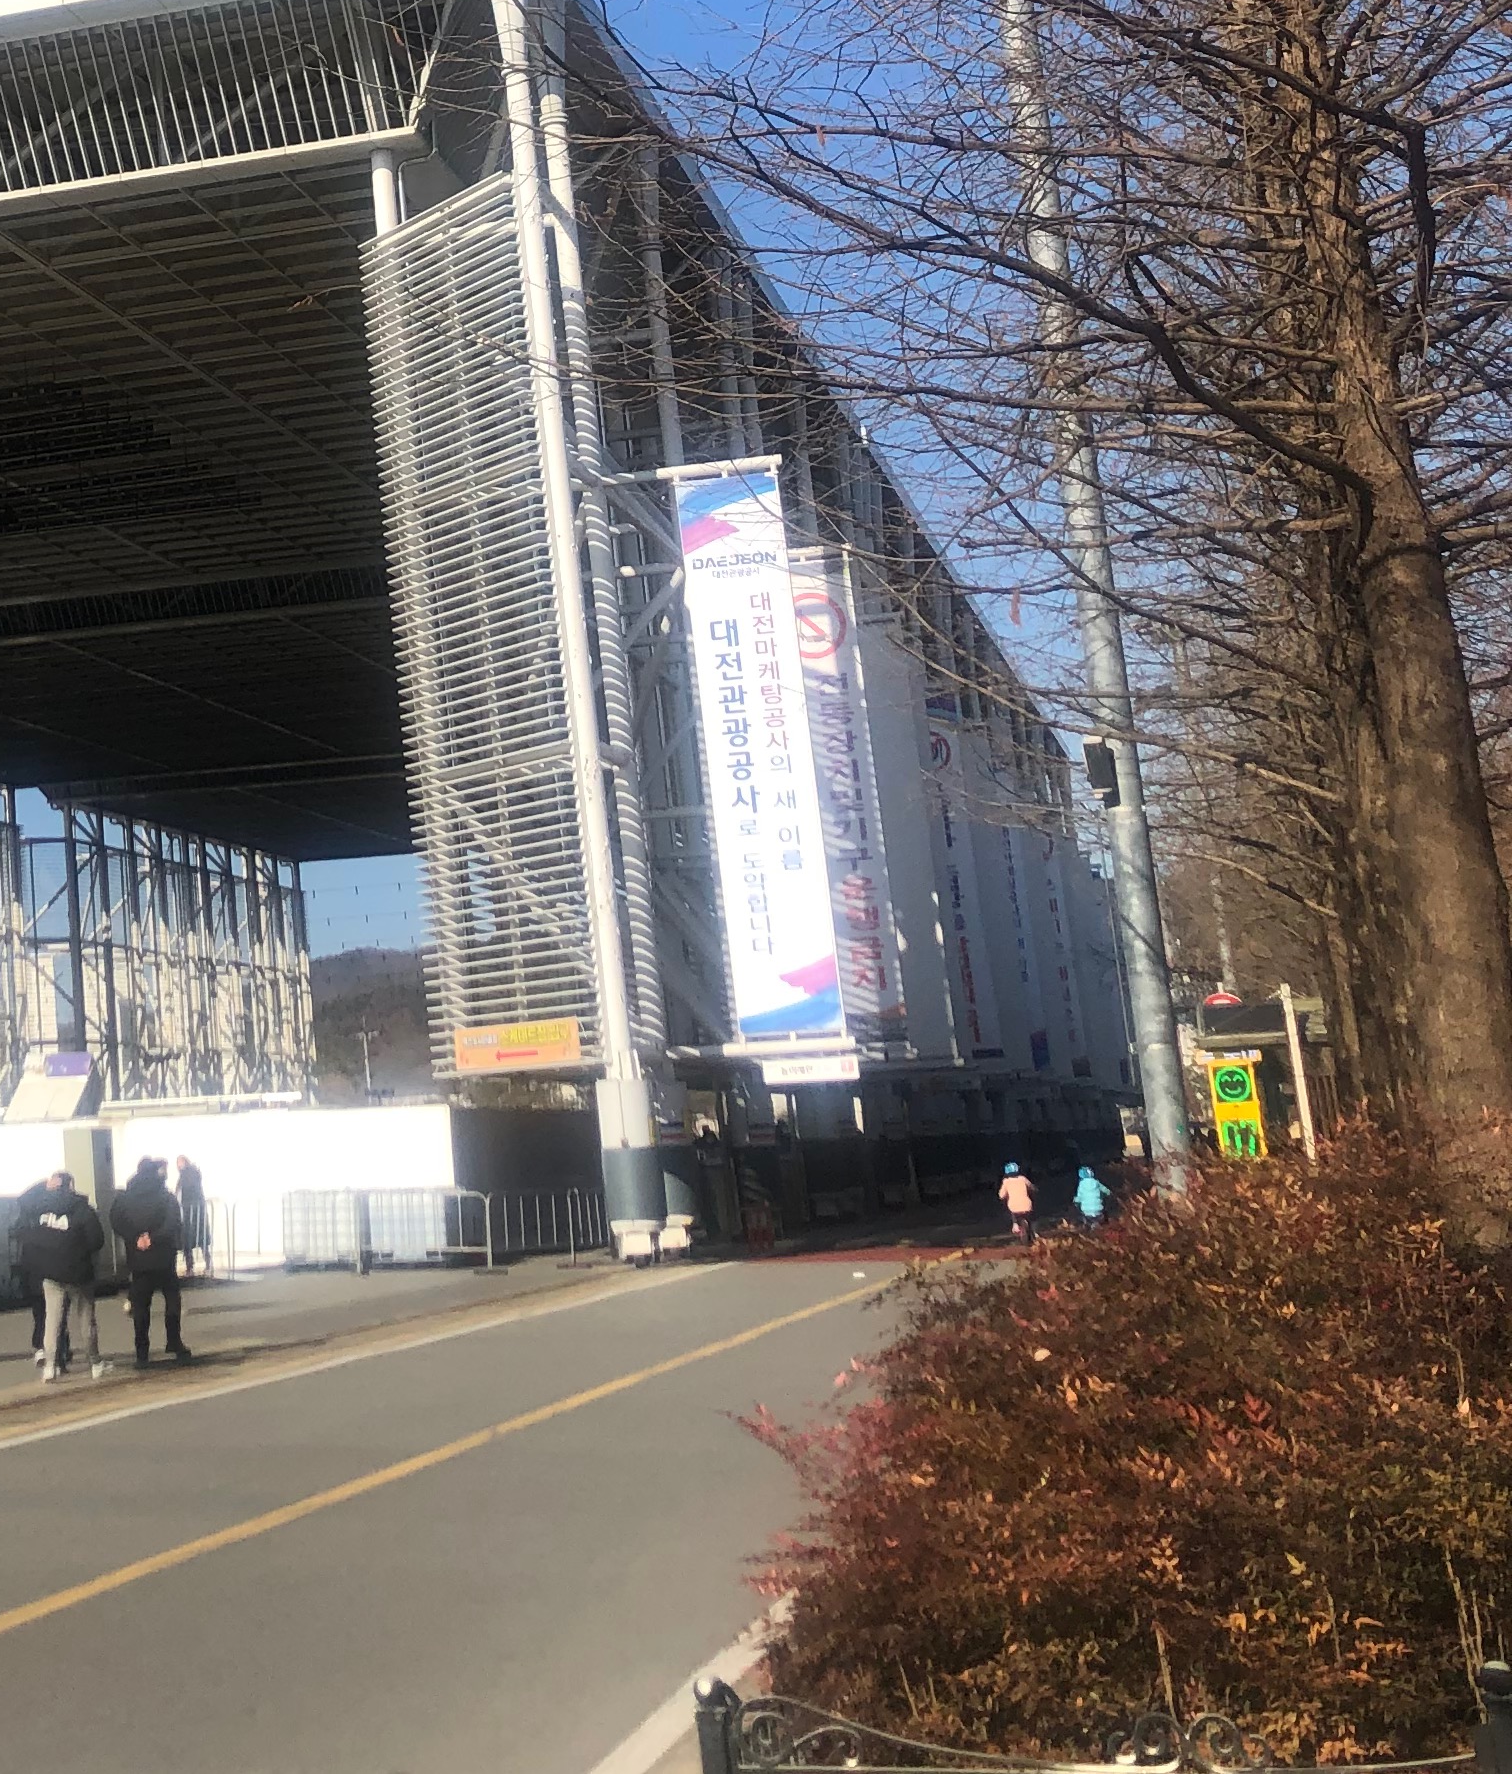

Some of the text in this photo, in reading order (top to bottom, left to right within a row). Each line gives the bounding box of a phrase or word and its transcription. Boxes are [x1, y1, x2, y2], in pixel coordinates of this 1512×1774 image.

[692, 550, 777, 571] DAEJEON
[749, 590, 792, 774] 대전마케팅공사의
[774, 789, 797, 810] 새
[39, 1212, 69, 1231] FILA
